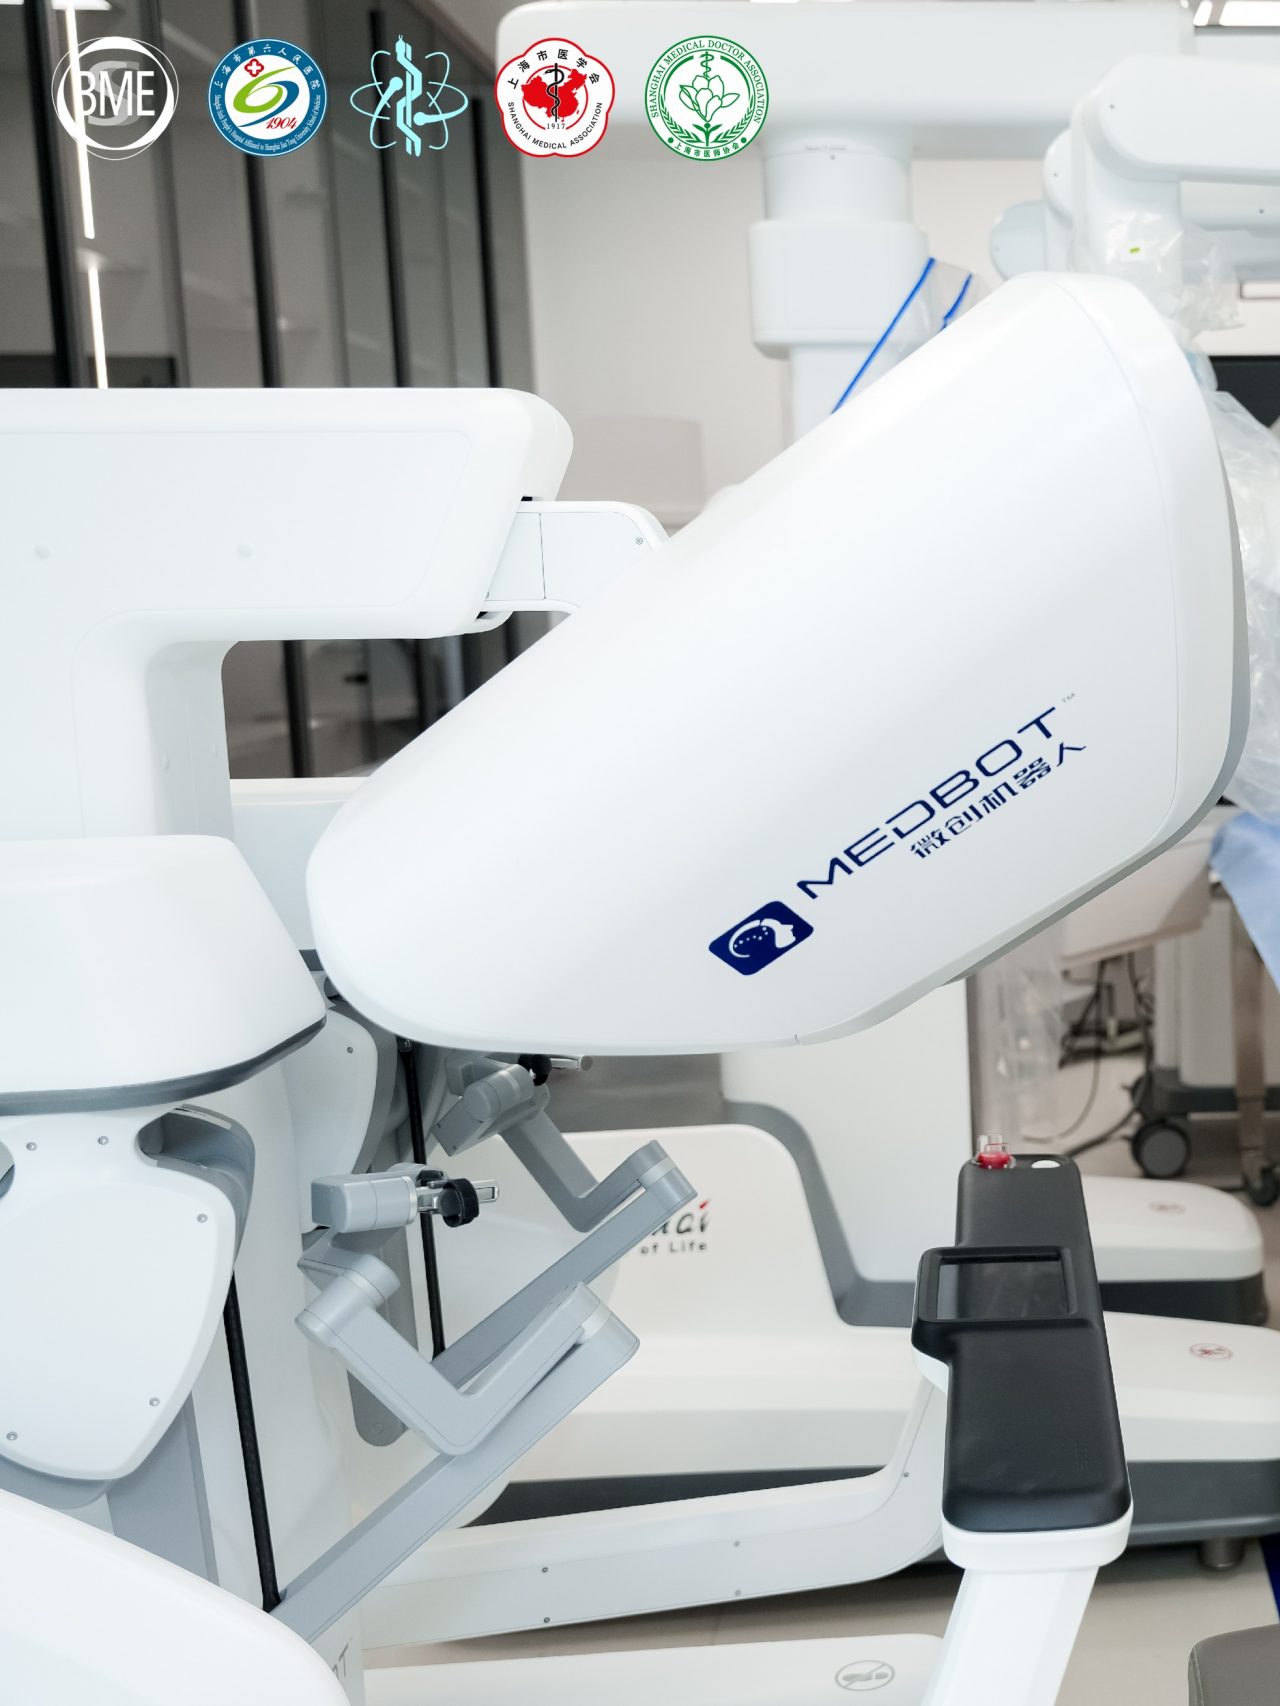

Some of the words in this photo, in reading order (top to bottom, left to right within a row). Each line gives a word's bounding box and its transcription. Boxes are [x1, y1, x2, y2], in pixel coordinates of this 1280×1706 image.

[796, 706, 1056, 900] MEDBOT
[909, 742, 1087, 860] 微创机器人
[641, 1242, 658, 1254] of
[669, 1240, 707, 1253] Life
